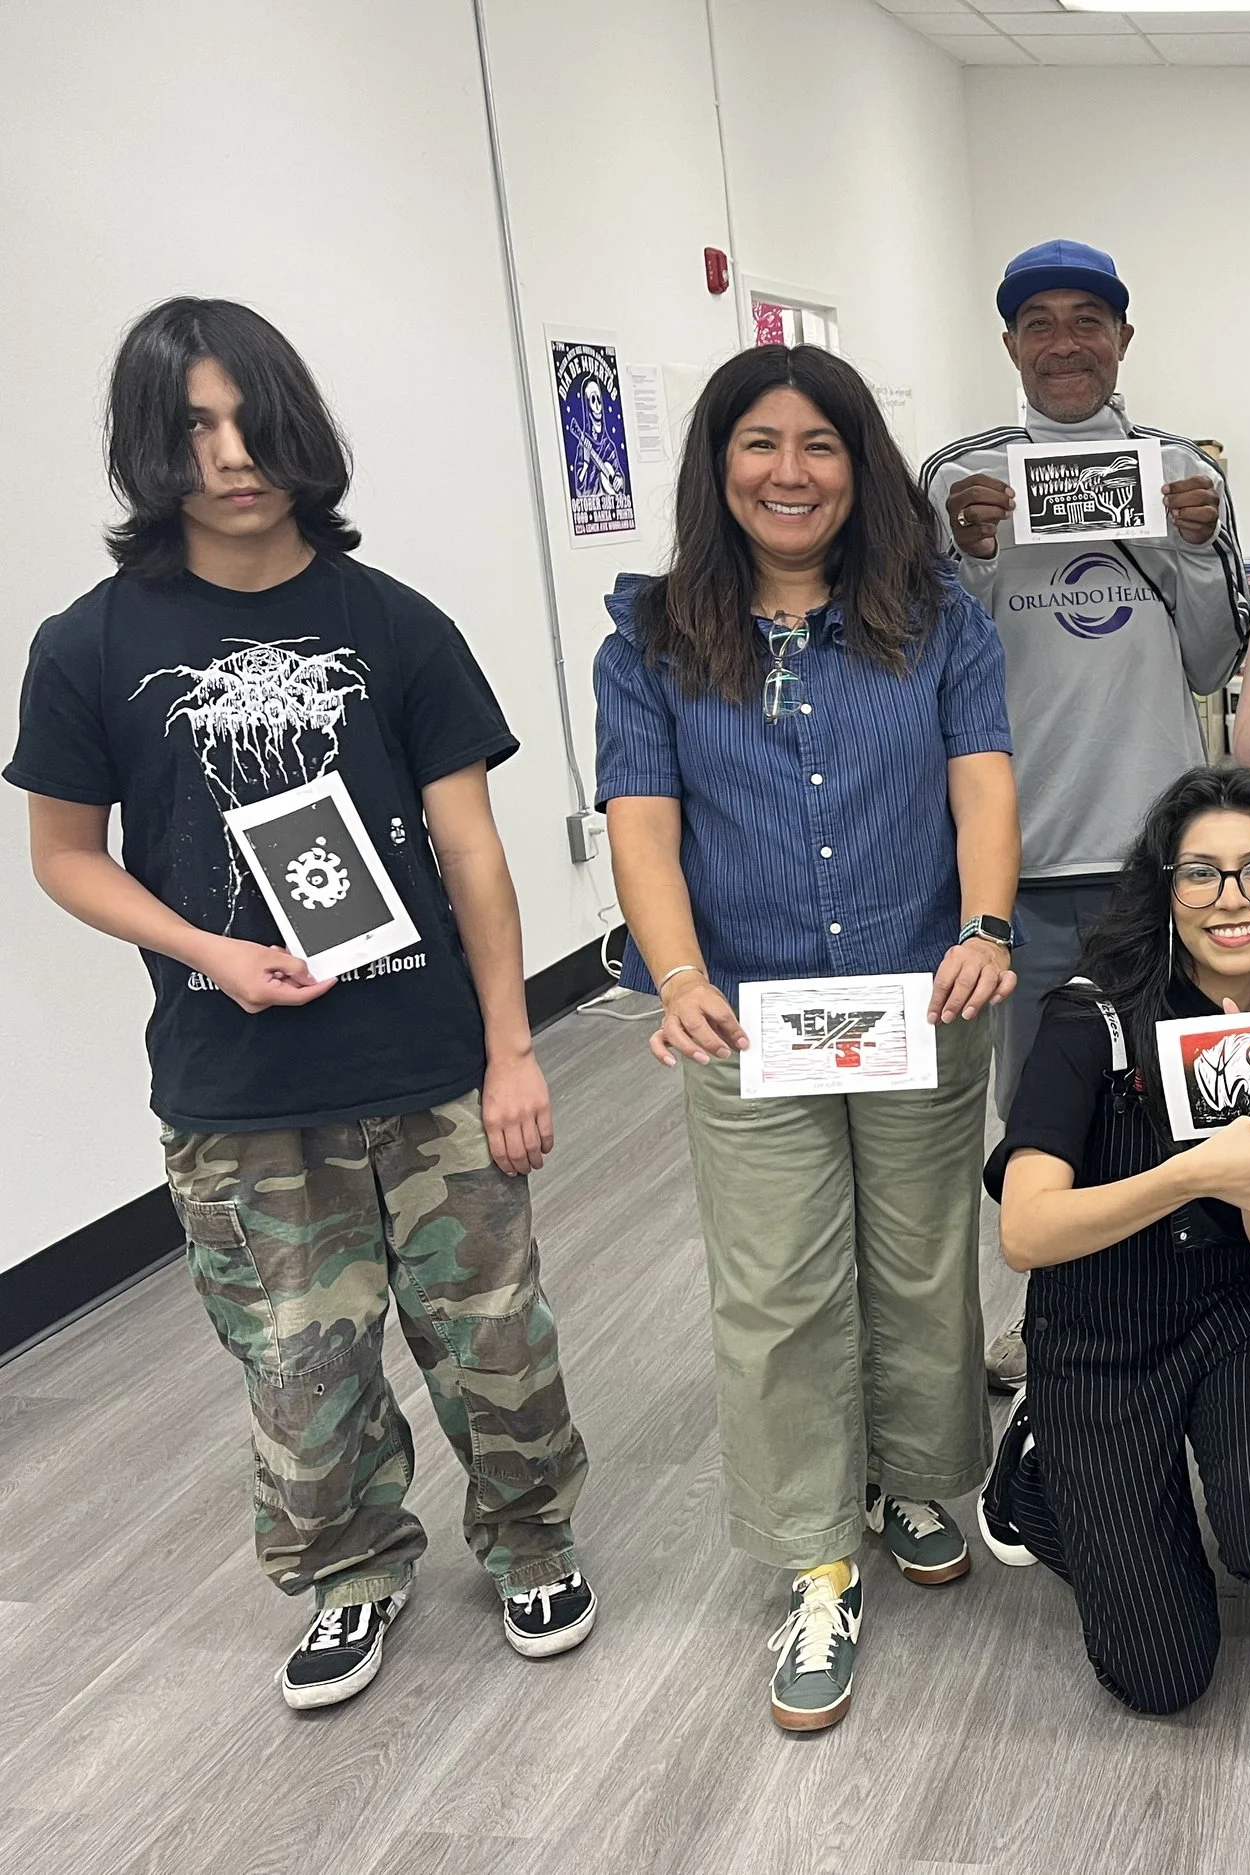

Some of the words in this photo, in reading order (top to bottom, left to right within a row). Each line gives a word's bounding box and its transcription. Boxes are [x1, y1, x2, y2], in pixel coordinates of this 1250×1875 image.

[568, 357, 581, 379] DE
[581, 355, 618, 401] MUERTOS
[571, 497, 602, 513] OCTOBER
[1008, 589, 1104, 612] ORLANDO
[366, 951, 427, 980] Moon
